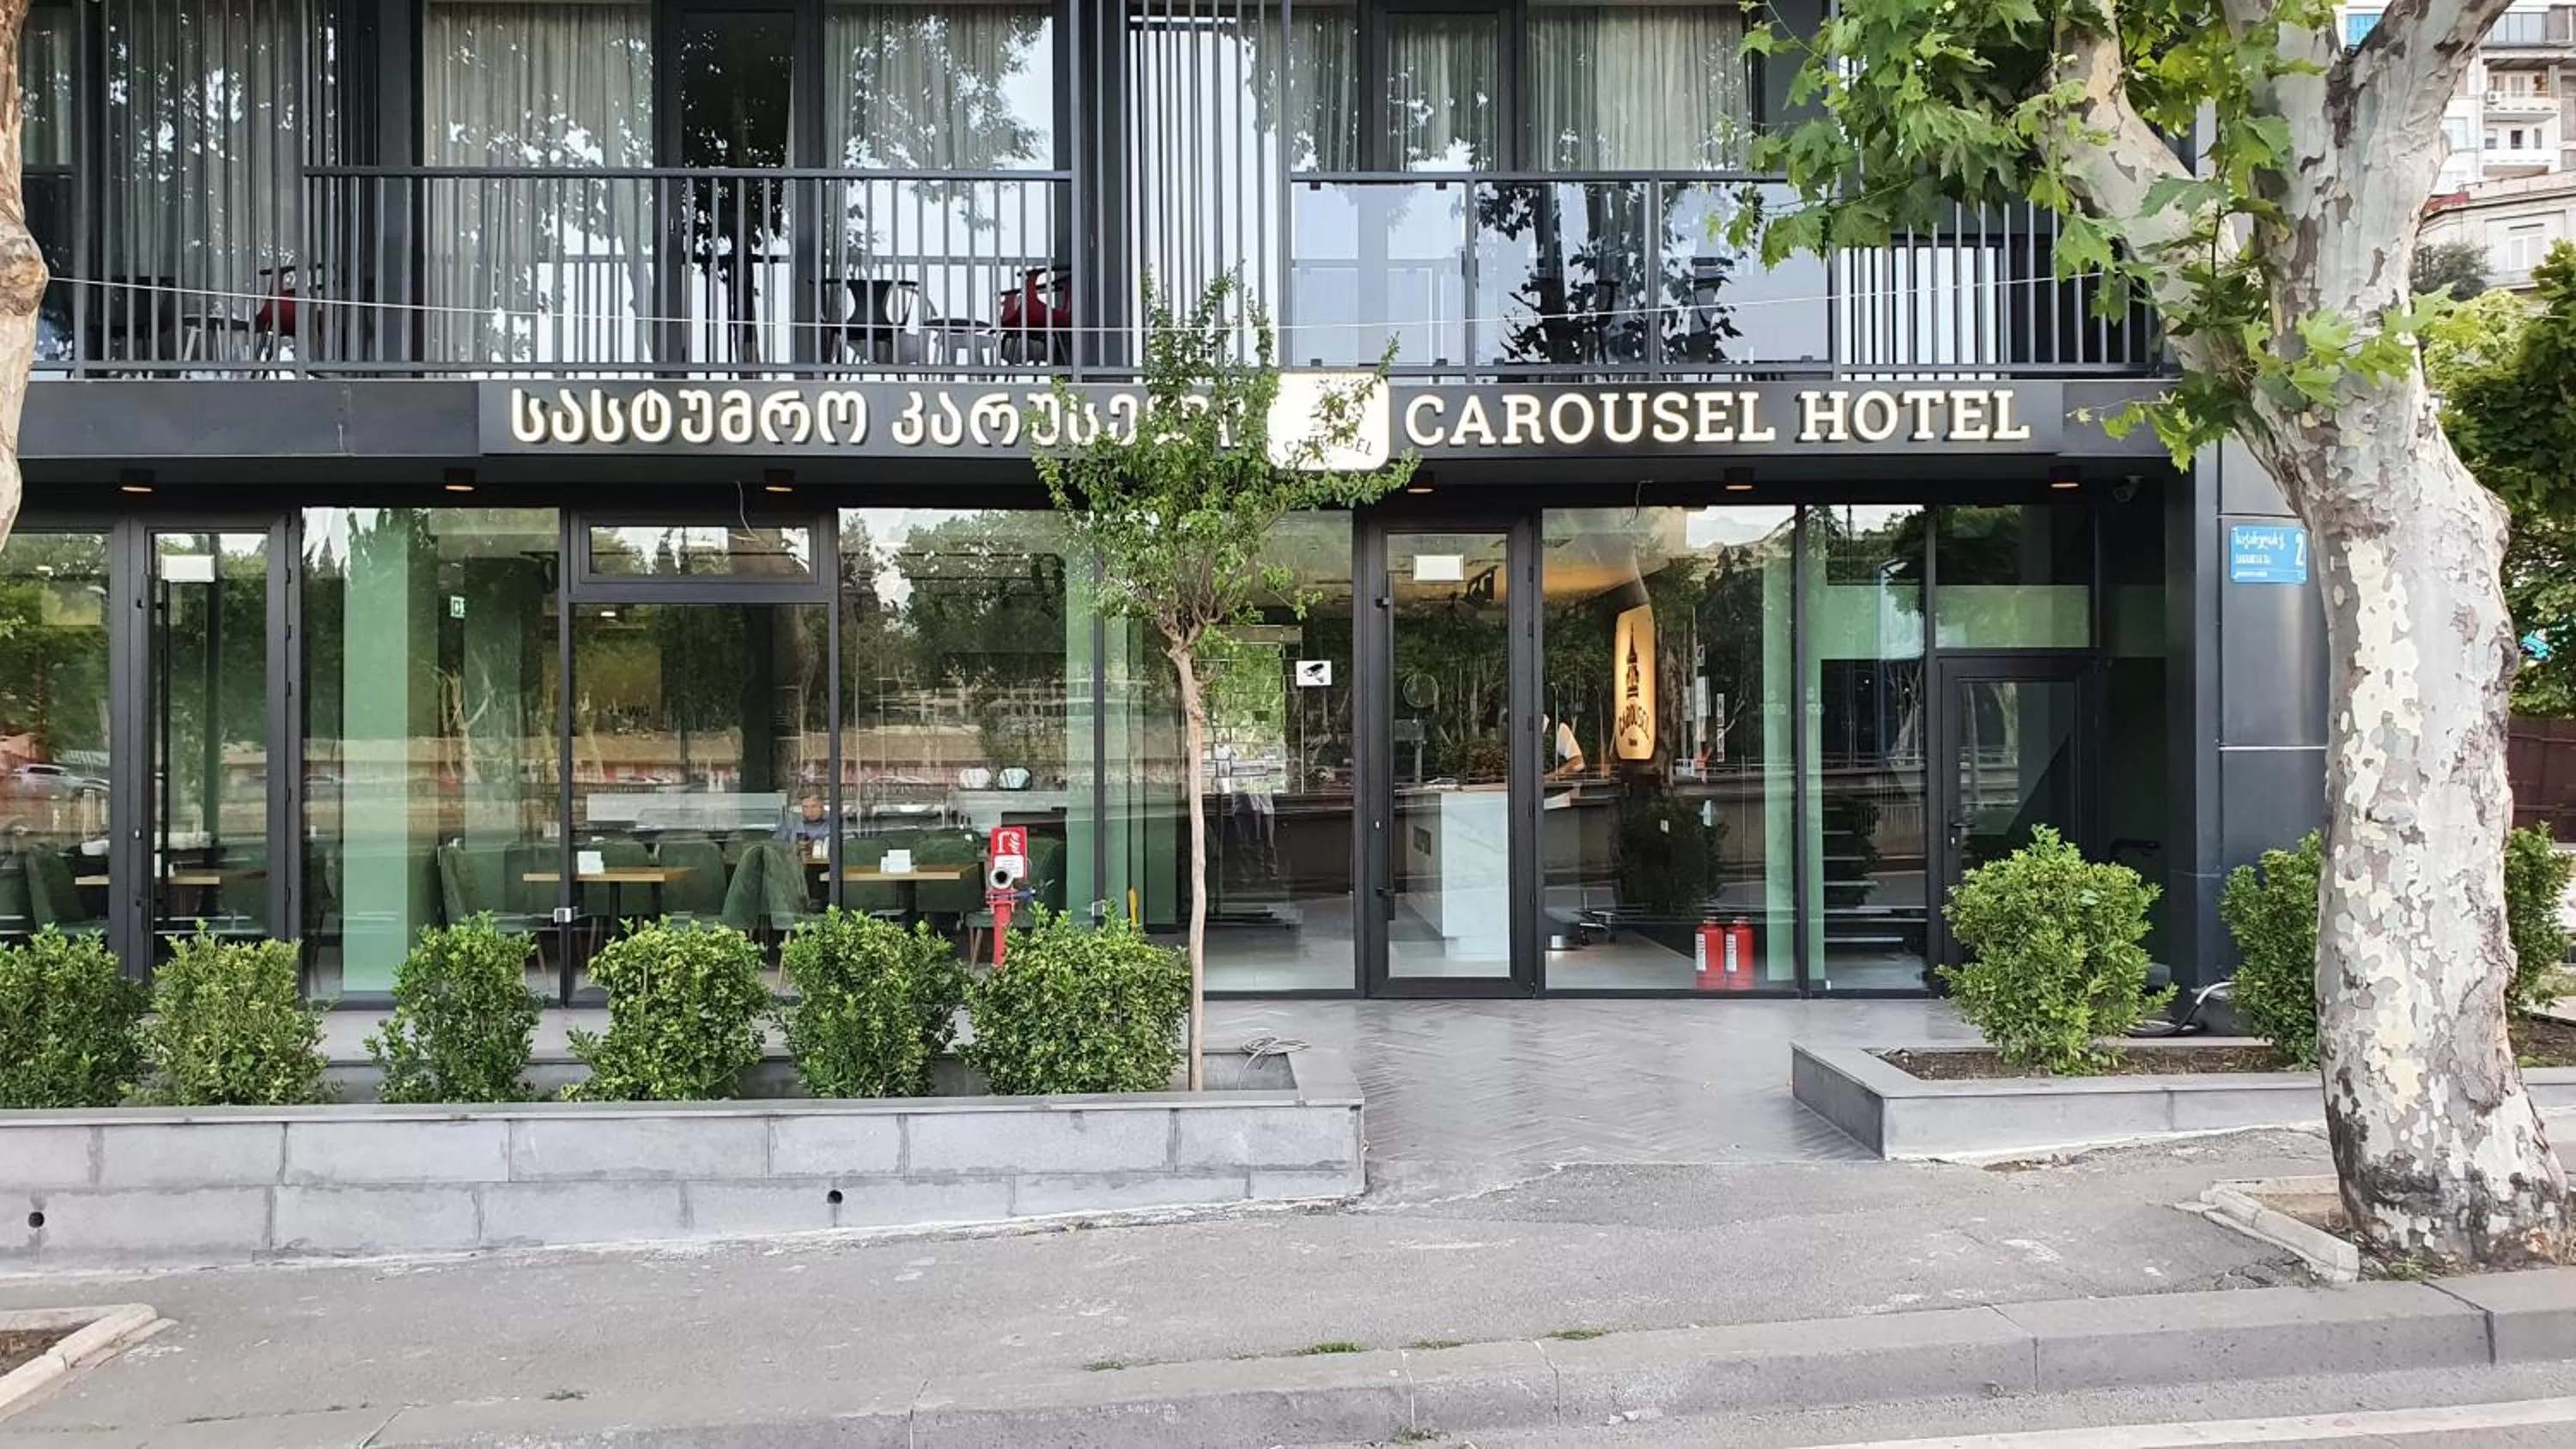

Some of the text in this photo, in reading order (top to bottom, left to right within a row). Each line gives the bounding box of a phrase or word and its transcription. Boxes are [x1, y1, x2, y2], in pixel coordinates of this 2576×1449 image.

[512, 388, 868, 444] სასტუმრო
[1405, 390, 2031, 446] CAROUSEL HOTEL
[2294, 532, 2305, 567] 2
